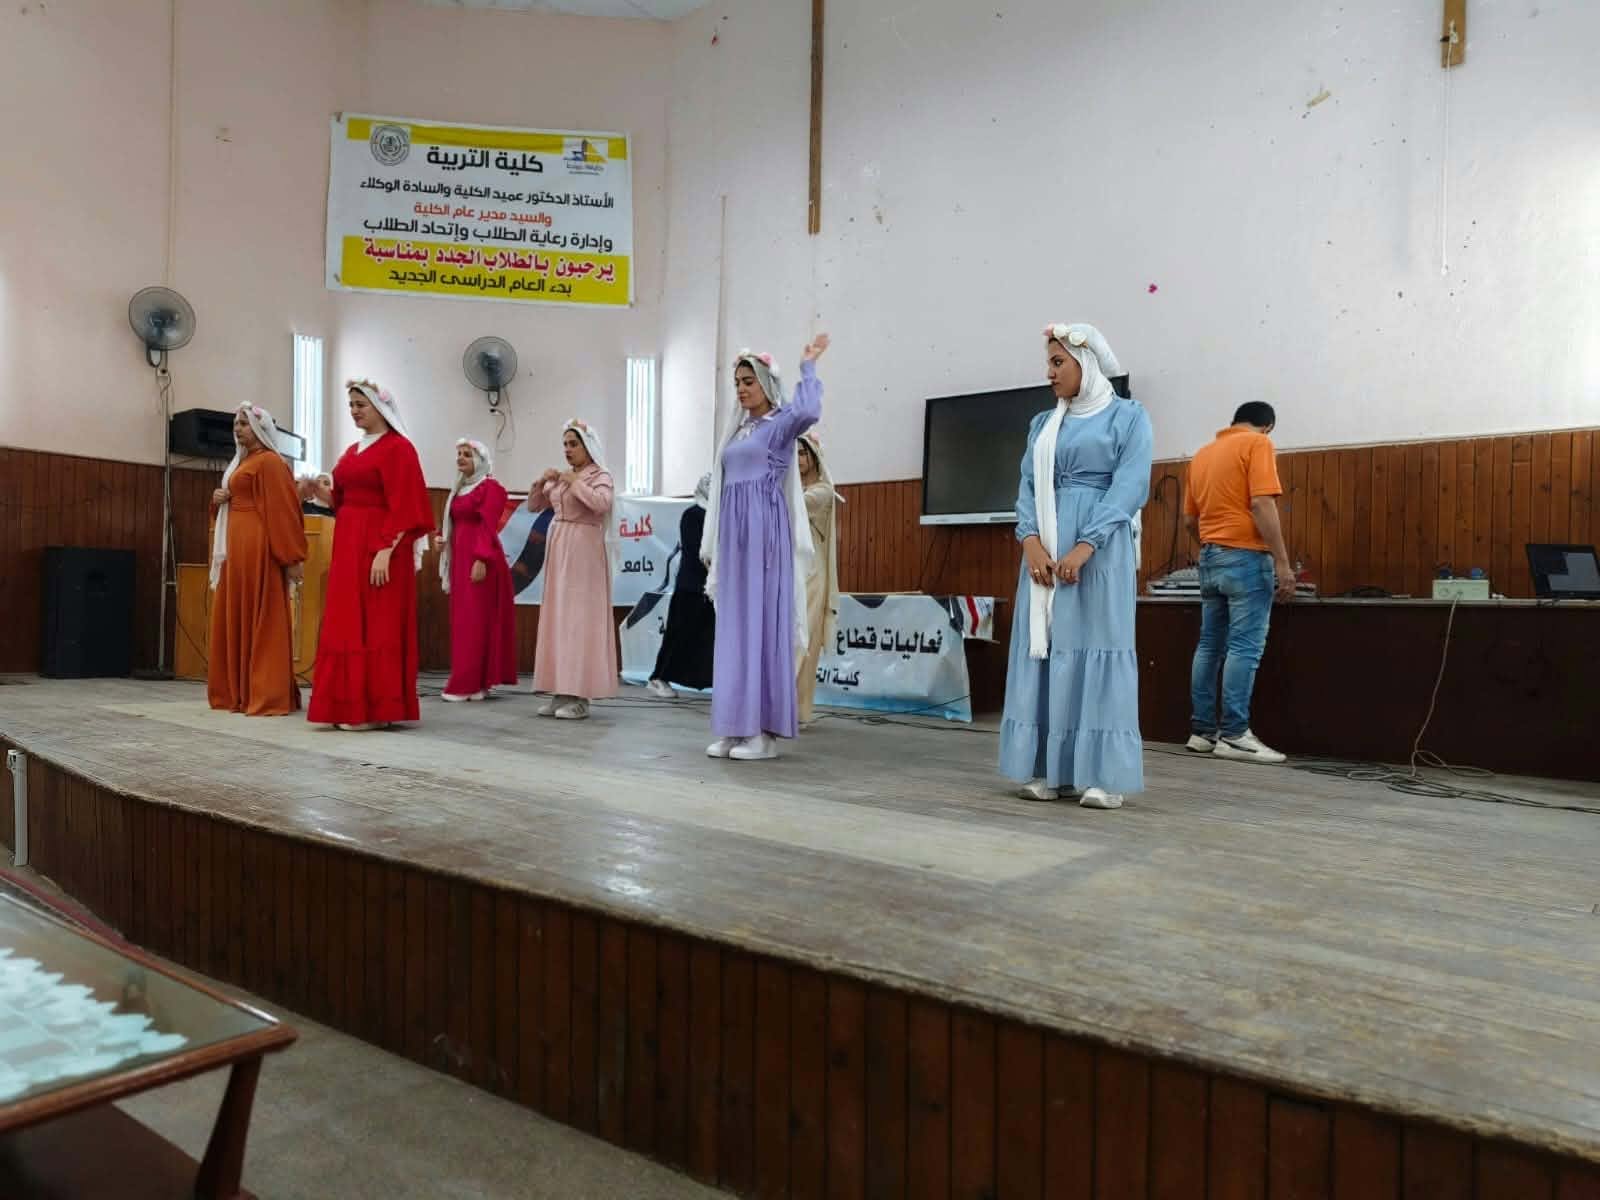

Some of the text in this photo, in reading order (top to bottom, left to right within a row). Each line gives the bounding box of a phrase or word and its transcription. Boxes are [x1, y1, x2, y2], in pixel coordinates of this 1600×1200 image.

[427, 145, 490, 171] التربية
[495, 151, 544, 177] كلية
[360, 177, 614, 209] الأستاذ الدكتور عميد الكلية والسادة الوكلاء
[414, 201, 552, 228] والسيد مدير عام الكلية
[363, 217, 613, 253] وإدارة رعاية الطلاب وإتحاد الطلاب
[364, 237, 614, 281] يرحبون بالطلاب الجدد بمناسبة
[389, 269, 572, 297] بدء العام الدراسى الجديد
[619, 513, 653, 543] كلية
[621, 555, 654, 577] جامع
[836, 626, 943, 660] فعاليات قطاع
[832, 668, 860, 691] كلية
